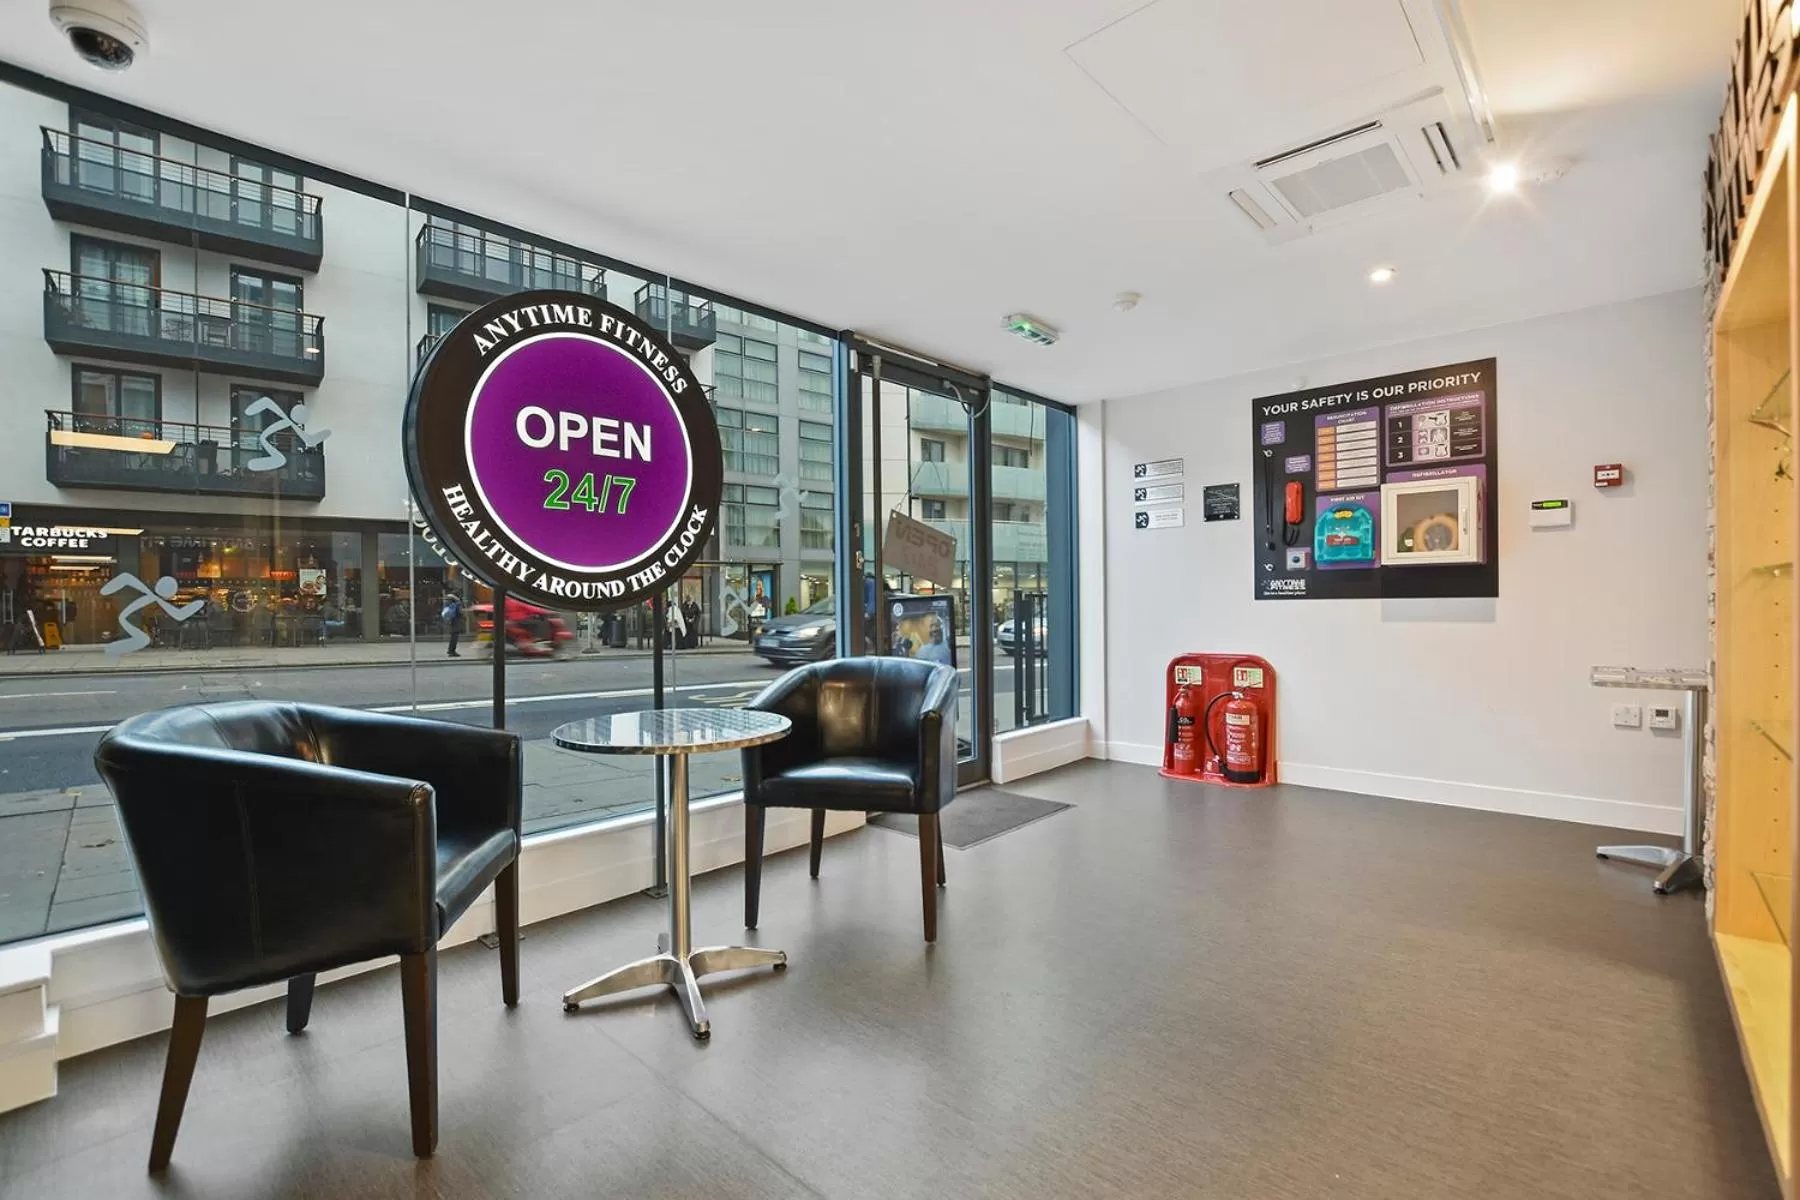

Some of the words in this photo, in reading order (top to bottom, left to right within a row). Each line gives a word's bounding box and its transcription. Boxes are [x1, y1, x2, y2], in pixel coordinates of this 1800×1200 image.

[473, 304, 592, 356] ANYTIME
[599, 311, 689, 395] FITNESS
[1262, 402, 1298, 416] YOUR
[1301, 393, 1352, 410] SAFETY
[1356, 390, 1369, 402] IS
[1372, 385, 1404, 399] OUR
[1408, 372, 1482, 393] PRIORITY
[516, 405, 652, 462] OPEN
[1397, 436, 1404, 444] 2
[1398, 421, 1403, 429] 1
[543, 469, 637, 514] 24/7
[10, 526, 108, 539] TARBUCKS
[20, 537, 89, 548] COFFEE
[442, 483, 538, 586] HEALTHY
[533, 570, 626, 600] AROUND
[627, 560, 667, 586] THE
[665, 504, 708, 567] CLOCK
